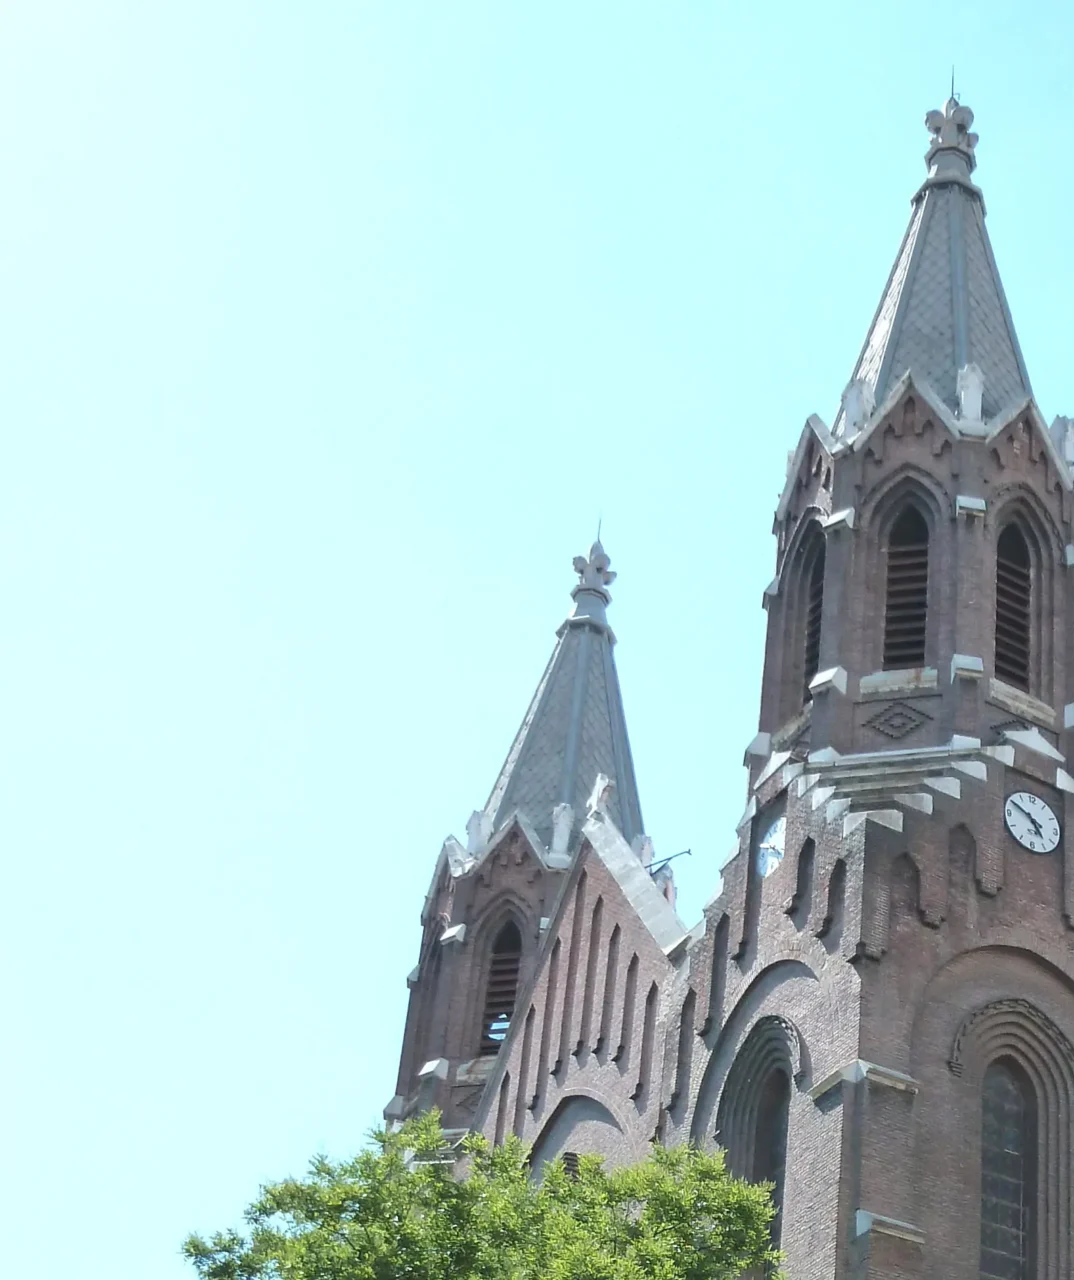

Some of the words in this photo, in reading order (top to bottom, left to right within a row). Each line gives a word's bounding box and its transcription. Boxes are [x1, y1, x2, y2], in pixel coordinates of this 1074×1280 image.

[1028, 796, 1036, 805] 12
[1007, 809, 1012, 817] 9
[1030, 841, 1036, 849] 6
